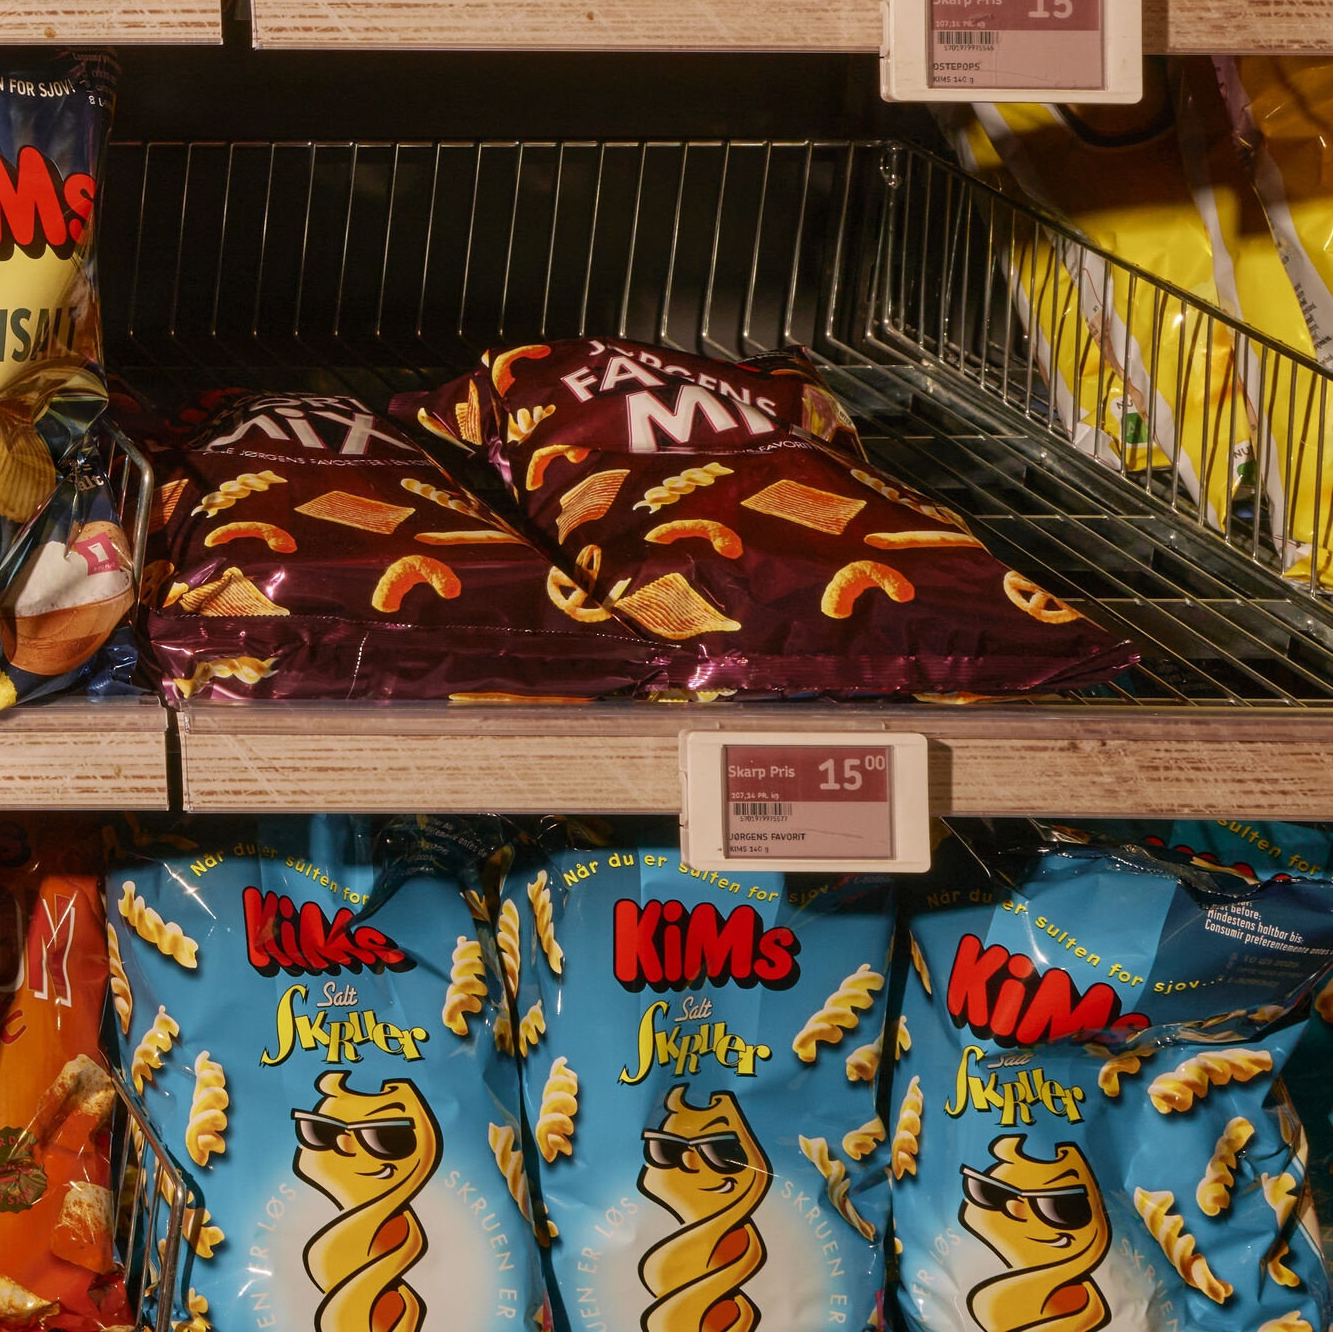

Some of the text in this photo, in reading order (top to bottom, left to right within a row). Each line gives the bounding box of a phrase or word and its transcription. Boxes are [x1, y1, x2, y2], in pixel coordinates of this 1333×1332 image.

[933, 62, 980, 71] OSTEPOPS
[728, 756, 885, 790] Skarp Pris 15 00
[729, 833, 768, 842] JØRGENS
[563, 852, 667, 887] Når du er
[748, 885, 780, 903] for
[613, 899, 801, 993] KiMs
[317, 981, 358, 1006] Salt
[675, 996, 713, 1022] Salt
